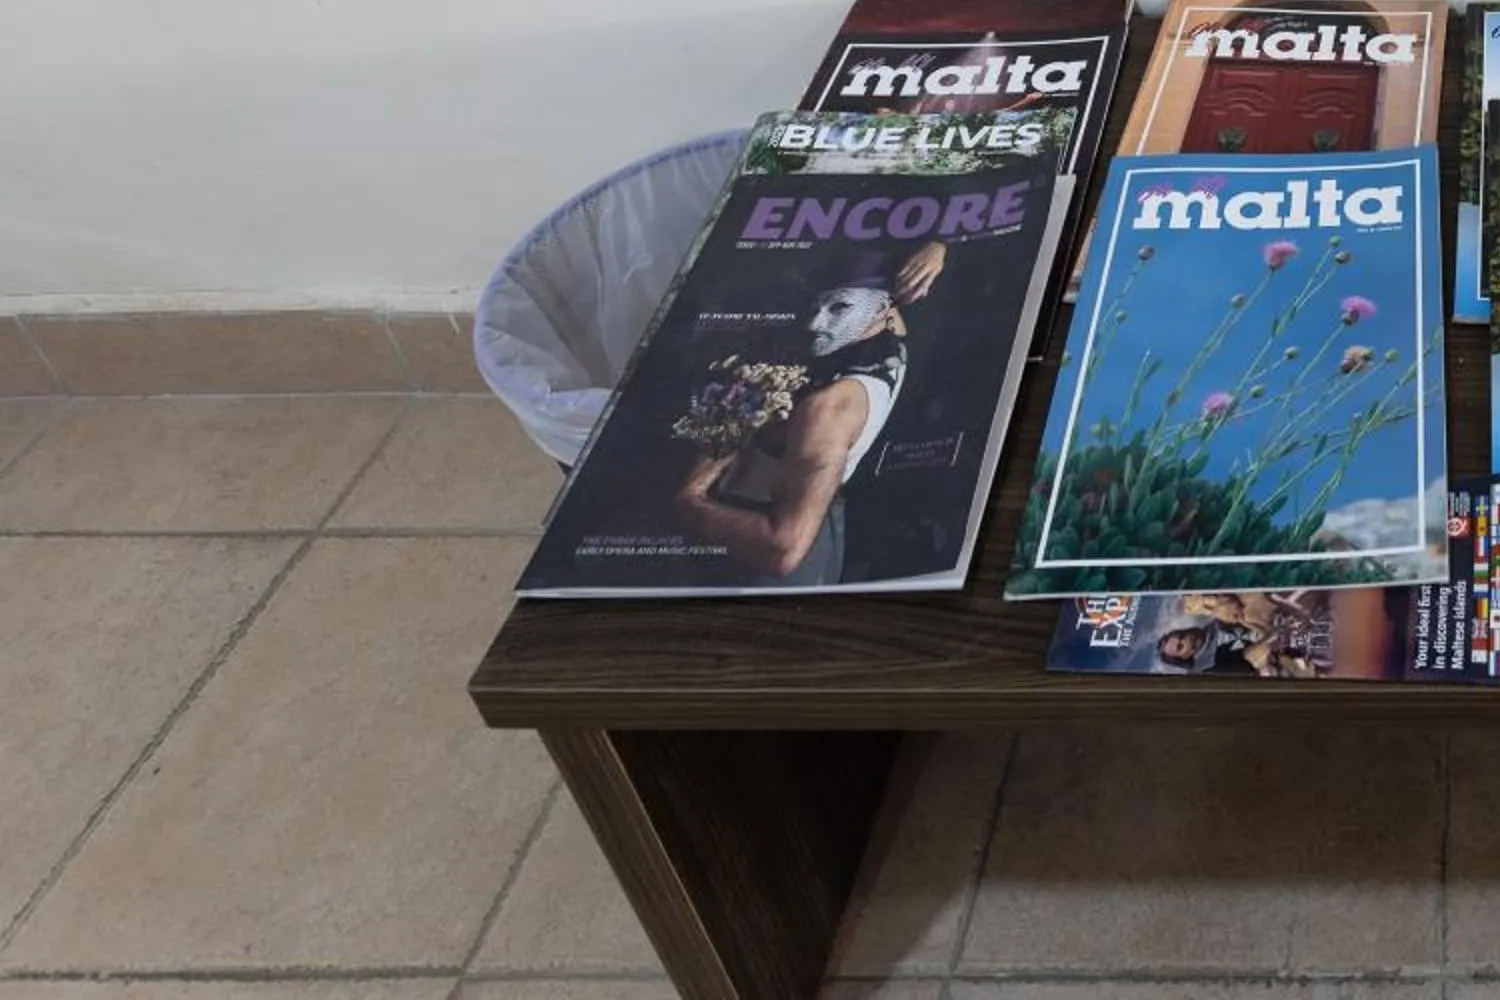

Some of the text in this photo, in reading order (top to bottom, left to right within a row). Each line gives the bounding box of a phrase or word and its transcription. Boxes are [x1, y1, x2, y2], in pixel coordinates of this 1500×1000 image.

[1184, 25, 1418, 63] malta
[840, 55, 1088, 97] malta
[779, 124, 905, 151] BLUE
[912, 122, 1044, 150] LIVES
[741, 180, 1031, 240] ENCORE
[1133, 179, 1404, 230] malta
[1416, 609, 1431, 637] ideal
[1433, 587, 1453, 652] discovering
[1451, 579, 1468, 670] Maltese islands
[1414, 638, 1430, 669] Your
